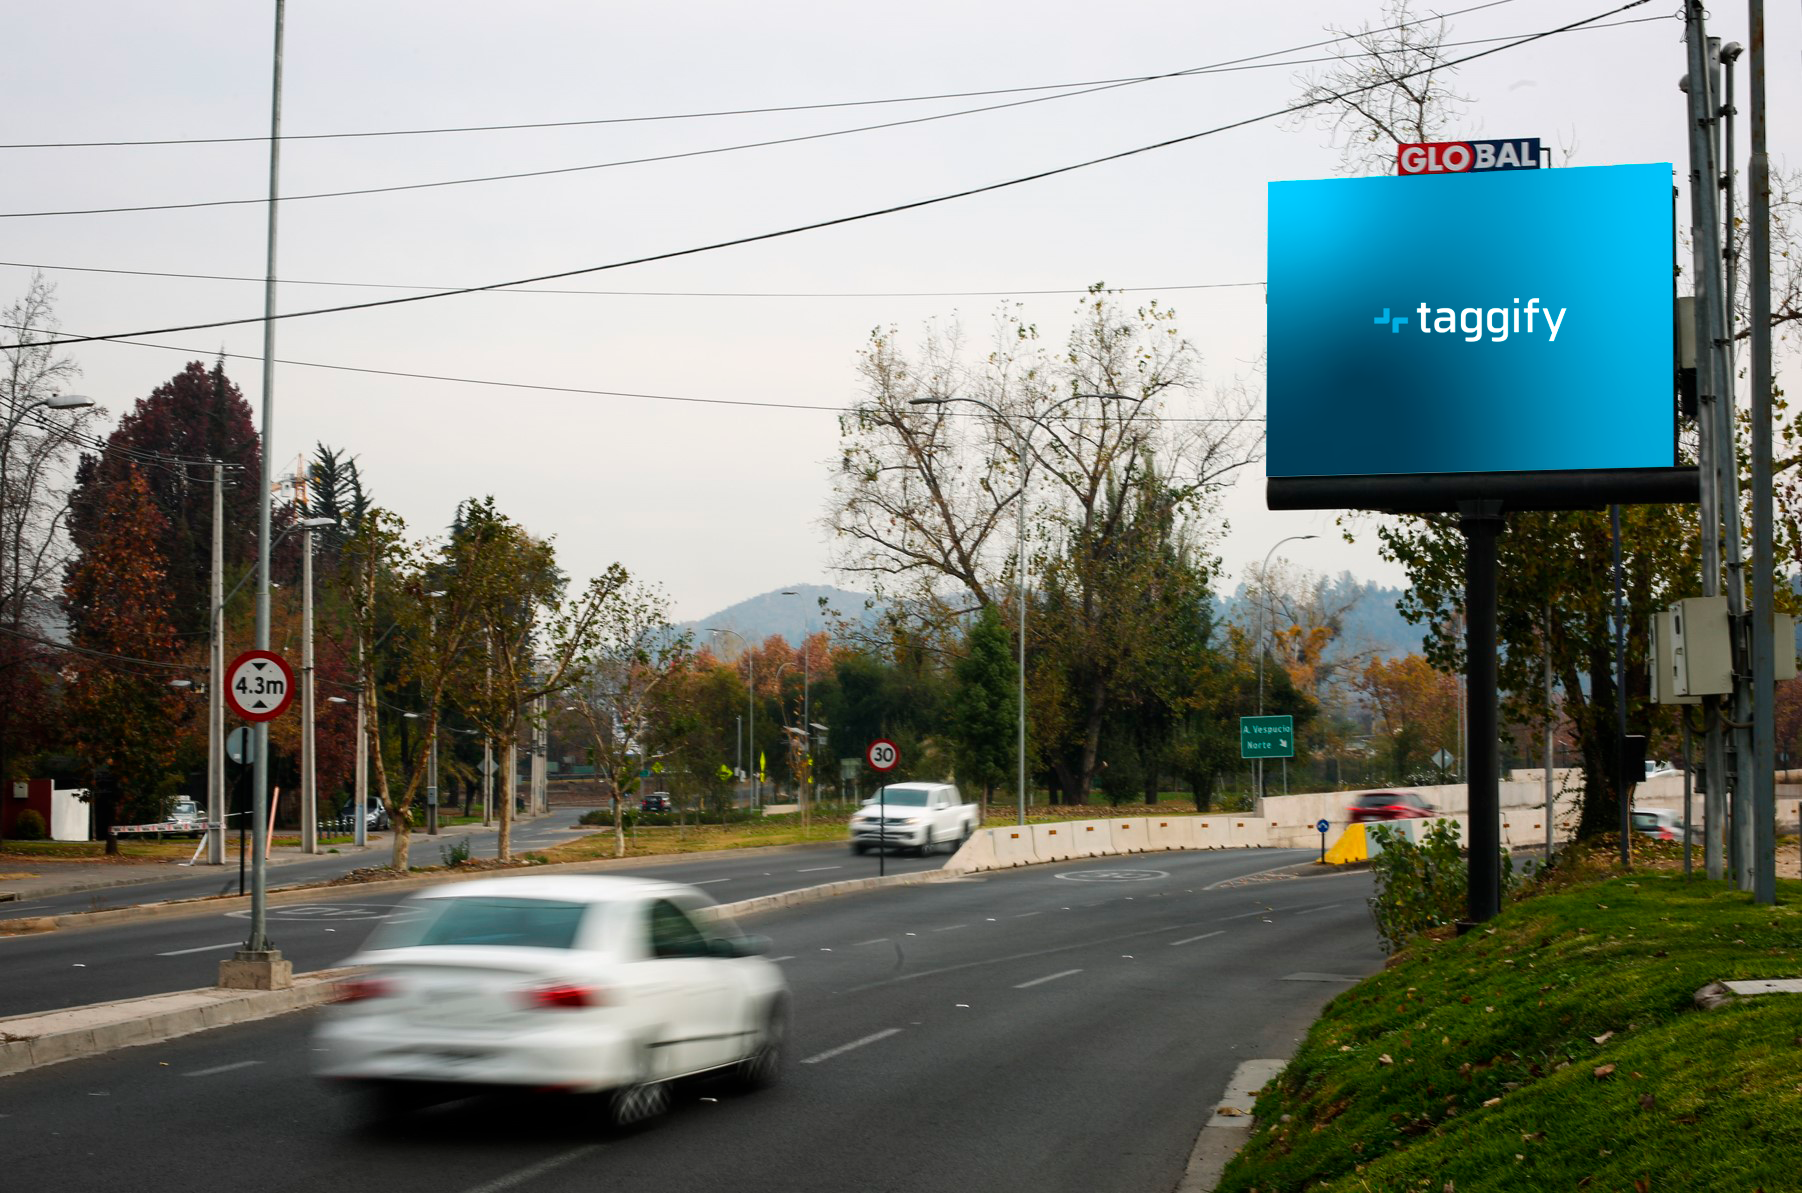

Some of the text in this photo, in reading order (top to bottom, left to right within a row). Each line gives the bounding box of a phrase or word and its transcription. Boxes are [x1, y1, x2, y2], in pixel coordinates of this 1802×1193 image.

[1401, 141, 1537, 173] GLOBAL
[1416, 298, 1567, 342] taggify
[235, 676, 284, 695] 4.3m
[1252, 724, 1291, 735] Vespucio
[874, 746, 894, 763] 30
[1247, 741, 1272, 750] Norte
